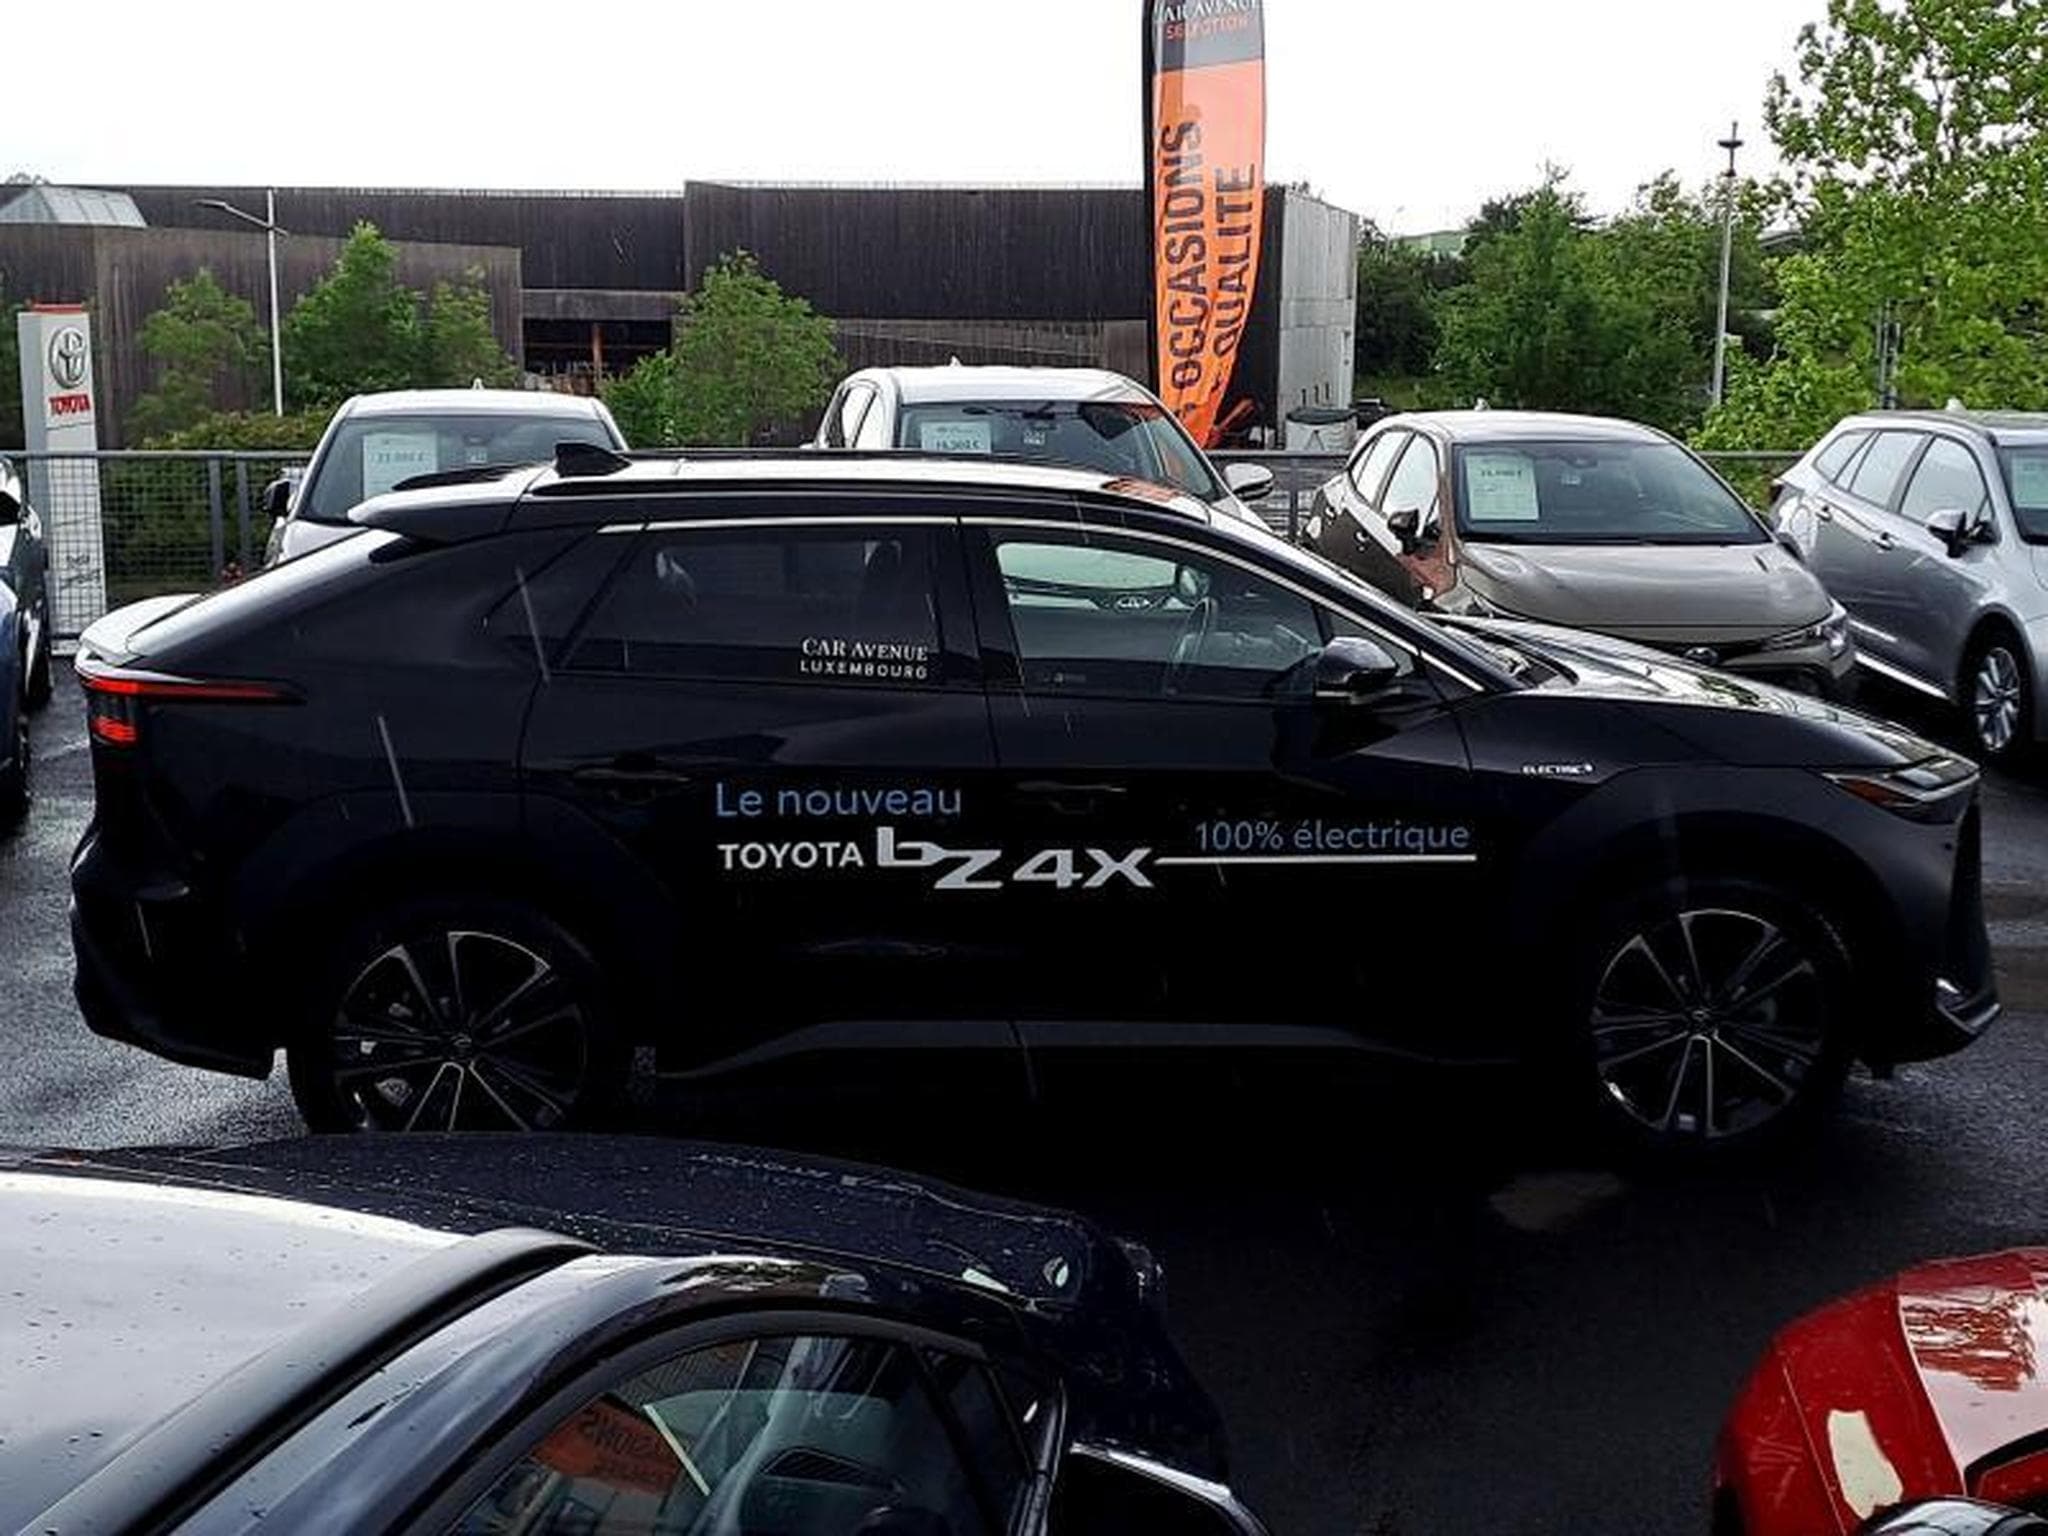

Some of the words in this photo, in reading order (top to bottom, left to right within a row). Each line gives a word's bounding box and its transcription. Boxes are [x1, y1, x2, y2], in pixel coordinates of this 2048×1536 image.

[1160, 122, 1209, 390] OCCASIONS
[1213, 163, 1255, 358] QUALITE
[48, 394, 91, 416] TOYOTA
[802, 637, 847, 657] CAR
[851, 642, 928, 661] AVENUE
[800, 660, 928, 679] LUXEMBOURG
[715, 782, 763, 817] Le
[777, 788, 962, 816] nouveau
[1195, 820, 1284, 851] 100%
[1293, 819, 1472, 854] électrique
[717, 842, 865, 870] TOYOTA
